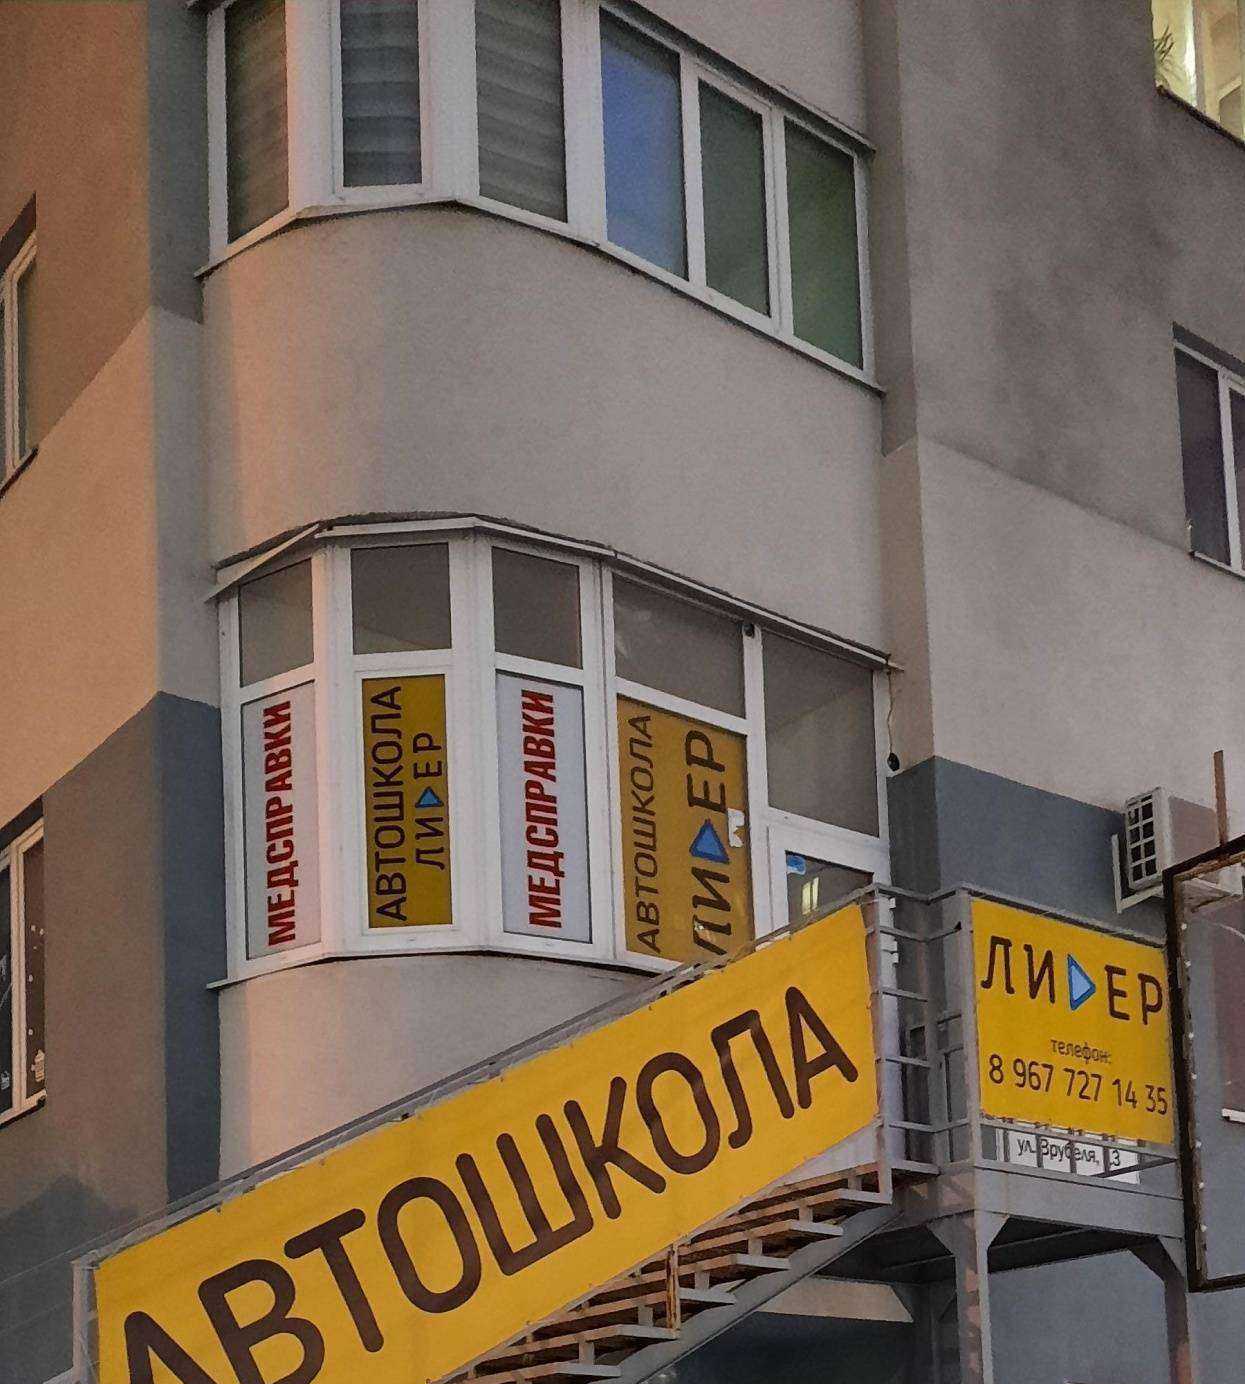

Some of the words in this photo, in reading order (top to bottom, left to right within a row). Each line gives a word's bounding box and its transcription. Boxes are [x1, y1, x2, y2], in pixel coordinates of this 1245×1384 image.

[263, 700, 297, 947] МЕДСПРАВКИ
[368, 685, 407, 922] АВТОШКОЛА
[520, 688, 562, 928] МЕДСПРАВКИ
[629, 713, 661, 954] АВТОШКОЛА
[989, 1054, 1004, 1084] 8
[1012, 1058, 1054, 1092] 967
[1063, 1067, 1104, 1102] 727
[1112, 1078, 1138, 1109] 14
[1145, 1084, 1168, 1116] 35
[1050, 1039, 1112, 1065] телефон:
